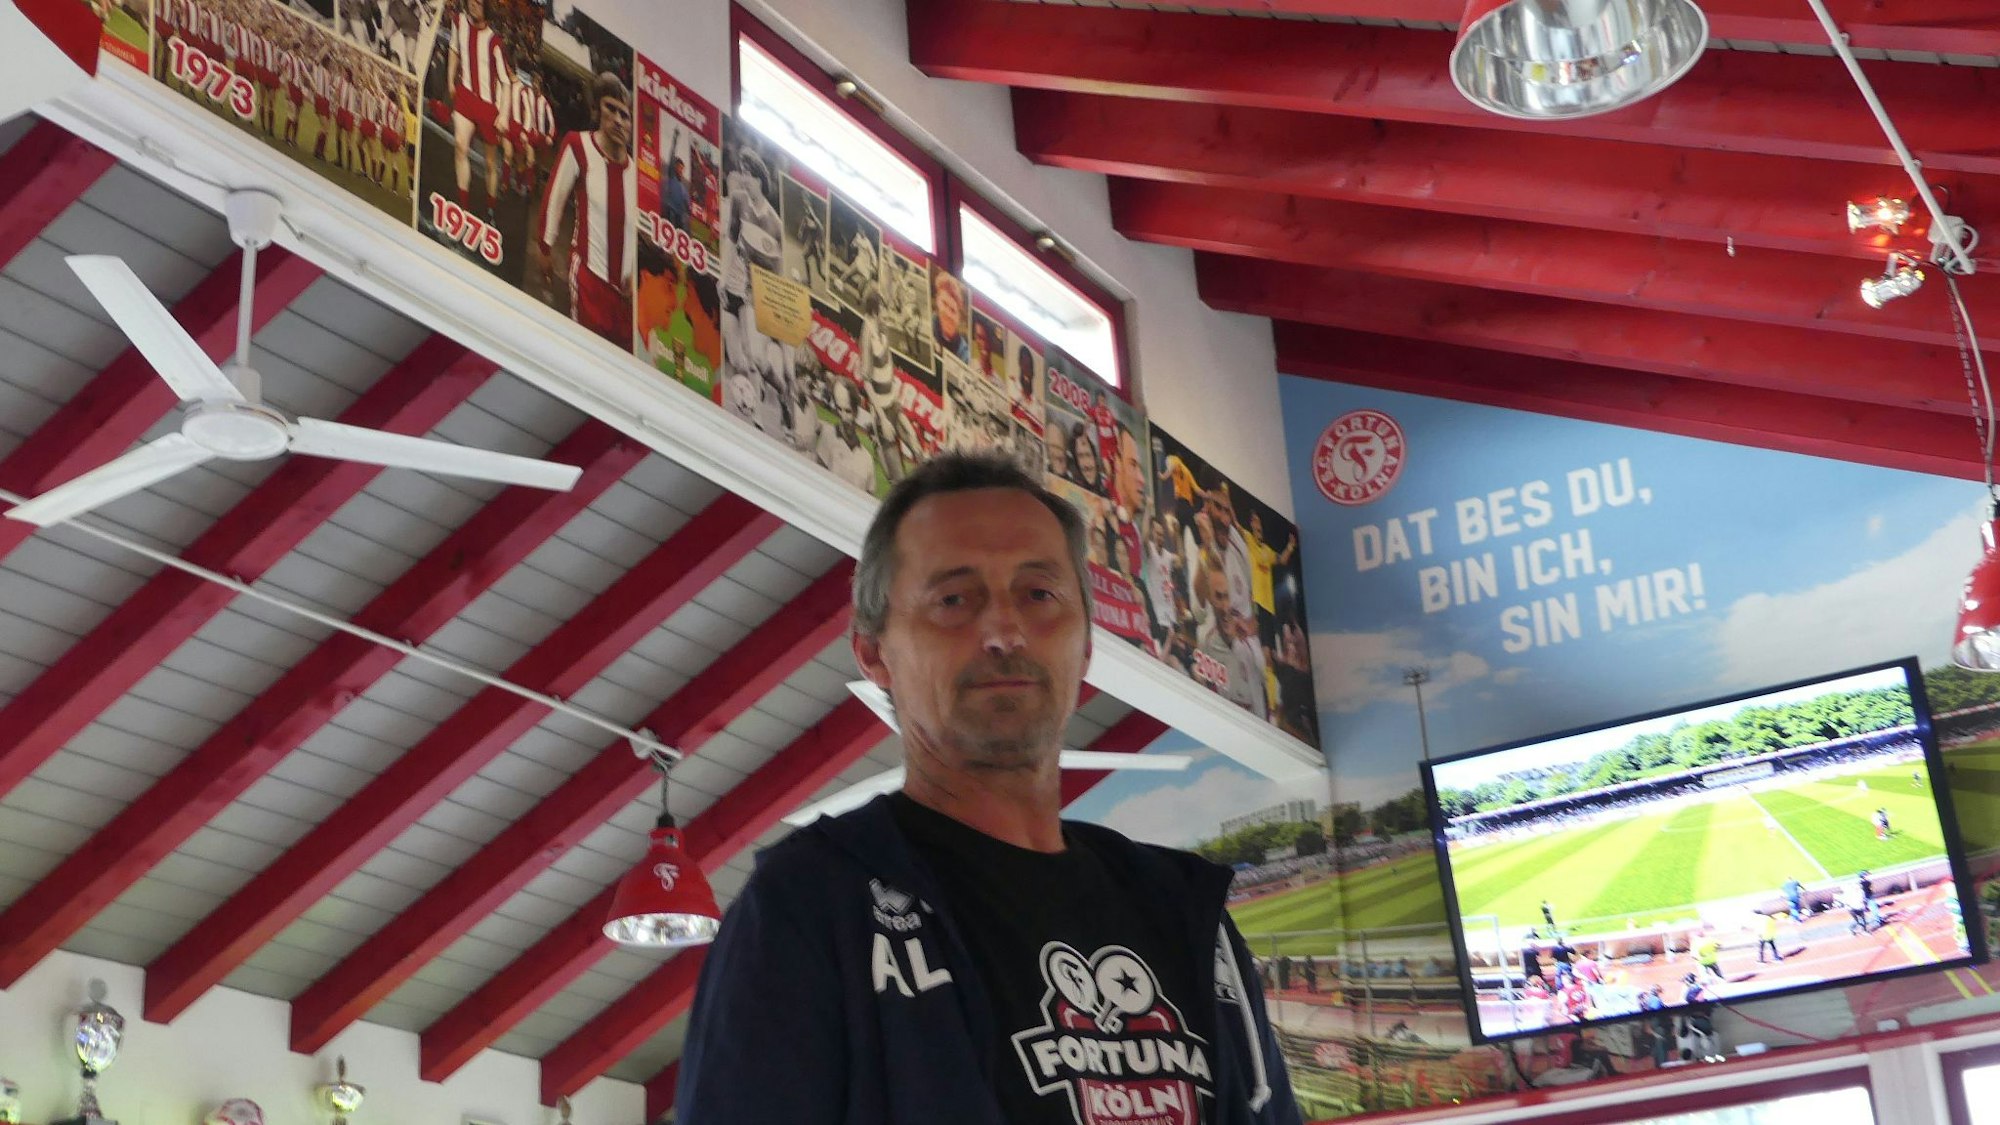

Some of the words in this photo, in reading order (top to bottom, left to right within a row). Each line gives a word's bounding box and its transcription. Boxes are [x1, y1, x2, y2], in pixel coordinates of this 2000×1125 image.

[167, 36, 255, 120] 1973
[637, 61, 707, 130] kicker
[429, 191, 504, 266] 1975
[648, 211, 708, 275] 1983
[1353, 508, 1438, 572] DAT
[1455, 480, 1553, 545] BES
[1567, 458, 1653, 518] DU,
[1419, 553, 1498, 613] BIN
[1512, 529, 1613, 591] ICH,
[1501, 593, 1581, 654] SIN
[1595, 563, 1707, 633] MIR!
[872, 933, 953, 998] AL
[1031, 1035, 1213, 1083] FORTUNA
[1087, 1083, 1183, 1119] KÖLN
